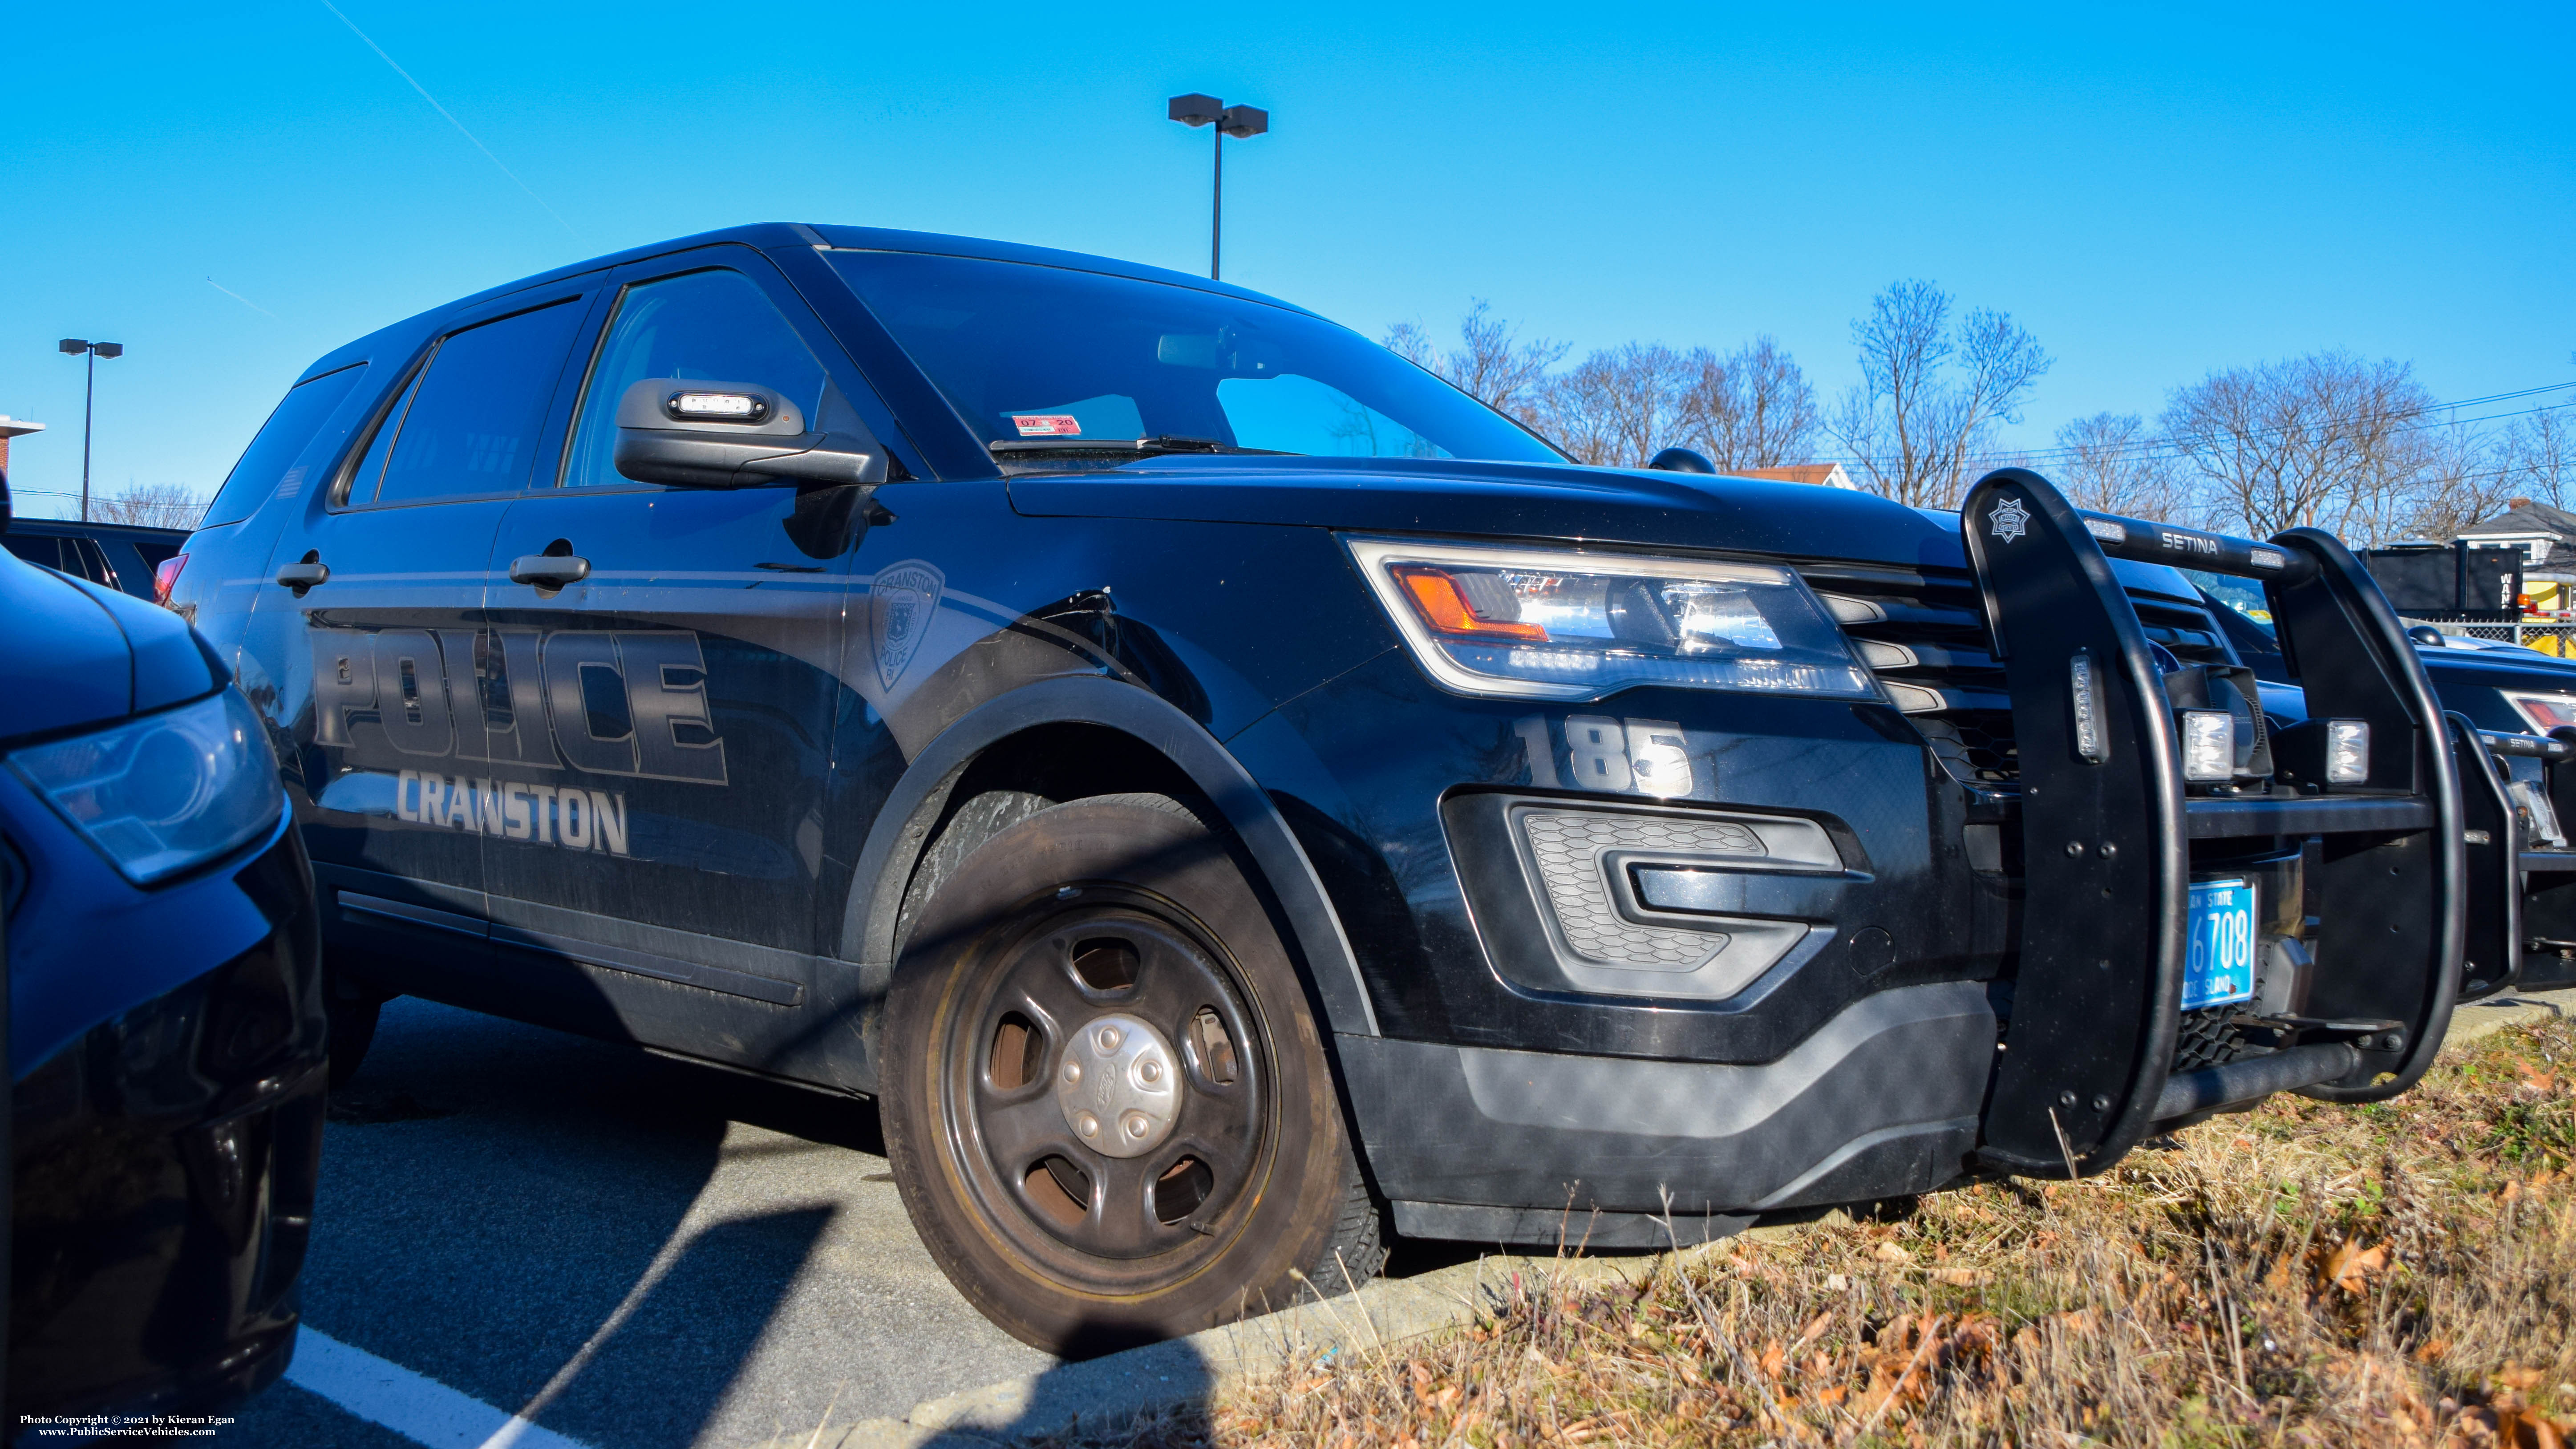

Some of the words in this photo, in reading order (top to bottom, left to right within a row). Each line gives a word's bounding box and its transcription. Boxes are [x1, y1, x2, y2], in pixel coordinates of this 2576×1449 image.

[2162, 533, 2217, 555] SETINA
[877, 571, 936, 598] CRANSTON
[880, 647, 907, 667] POLICE
[886, 669, 894, 680] RI
[311, 627, 729, 786] POLICE
[2510, 738, 2534, 748] SETINA
[1514, 713, 1692, 798] 185
[397, 769, 629, 858] CRANSTON
[2207, 891, 2233, 907] STATE
